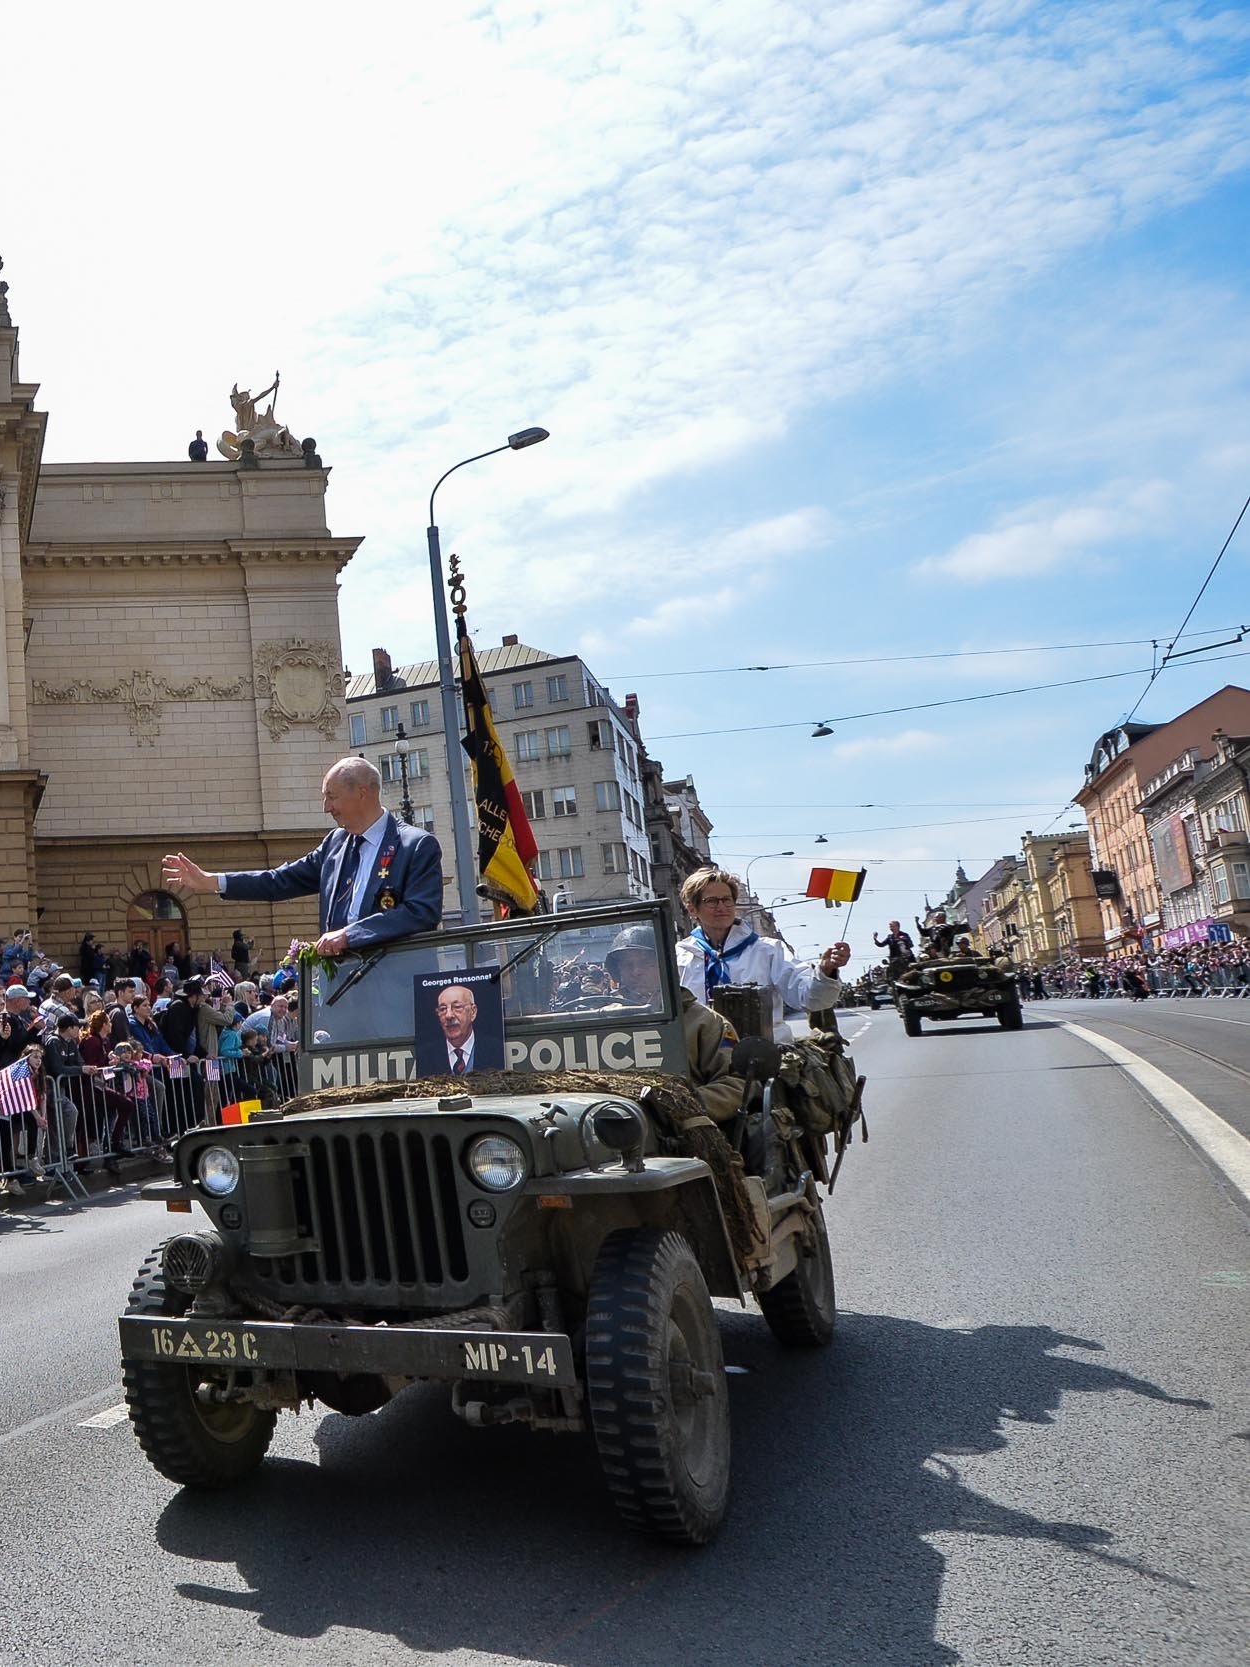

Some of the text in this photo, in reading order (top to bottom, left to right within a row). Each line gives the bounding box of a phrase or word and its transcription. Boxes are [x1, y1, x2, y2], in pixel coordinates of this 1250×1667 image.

[422, 973, 492, 987] Georges Rensonnet
[504, 1030, 664, 1072] POLICE
[464, 1342, 557, 1376] MP-14
